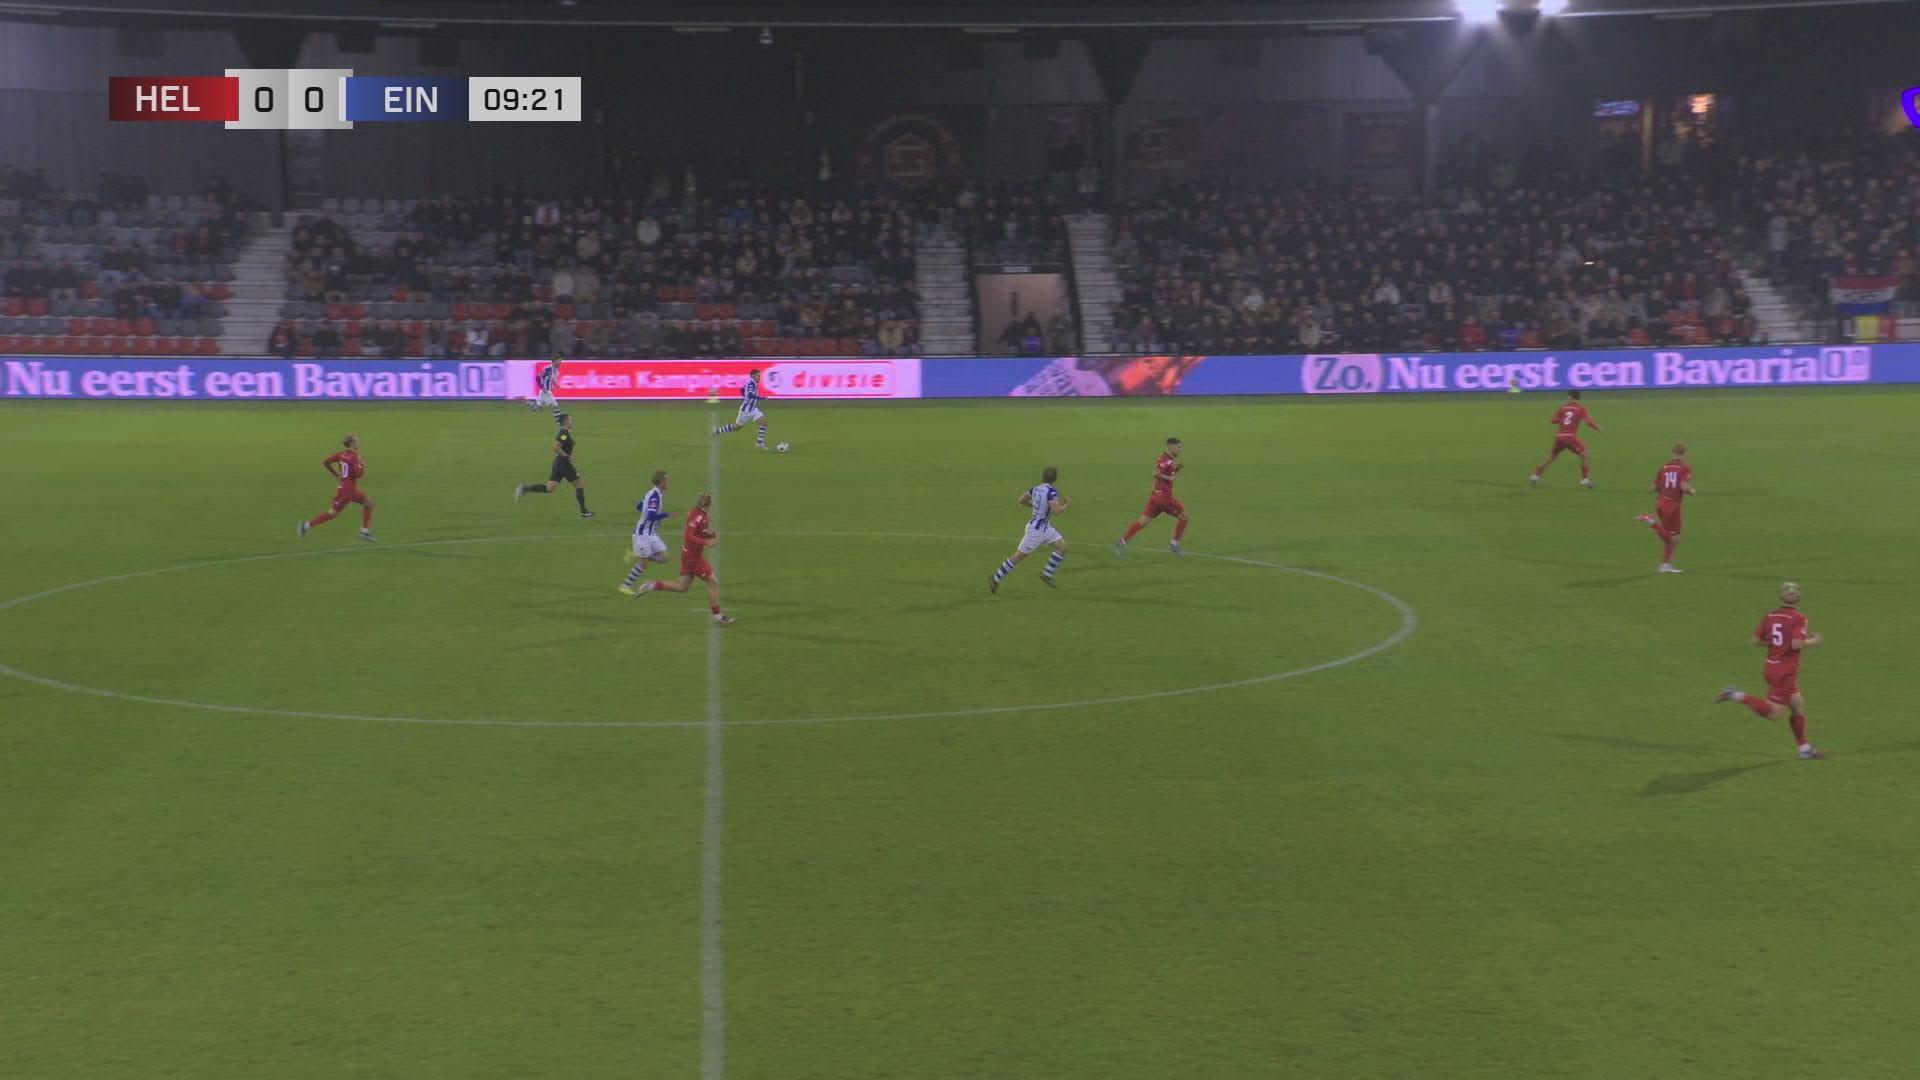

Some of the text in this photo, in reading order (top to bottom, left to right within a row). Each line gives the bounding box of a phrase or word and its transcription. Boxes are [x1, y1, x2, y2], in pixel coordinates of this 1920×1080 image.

[4, 361, 73, 396] Nu
[80, 364, 198, 397] eerst
[204, 371, 286, 397] een
[293, 362, 460, 397] Bavaria
[791, 370, 887, 389] divisie
[1313, 357, 1373, 390] Zo.
[1387, 357, 1447, 390] Nu
[1454, 356, 1560, 389] eerst
[1567, 360, 1645, 387] een
[1653, 348, 1819, 385] Bavaria
[1562, 411, 1574, 426] 2
[1664, 471, 1678, 490] 14
[1771, 623, 1784, 646] 5
